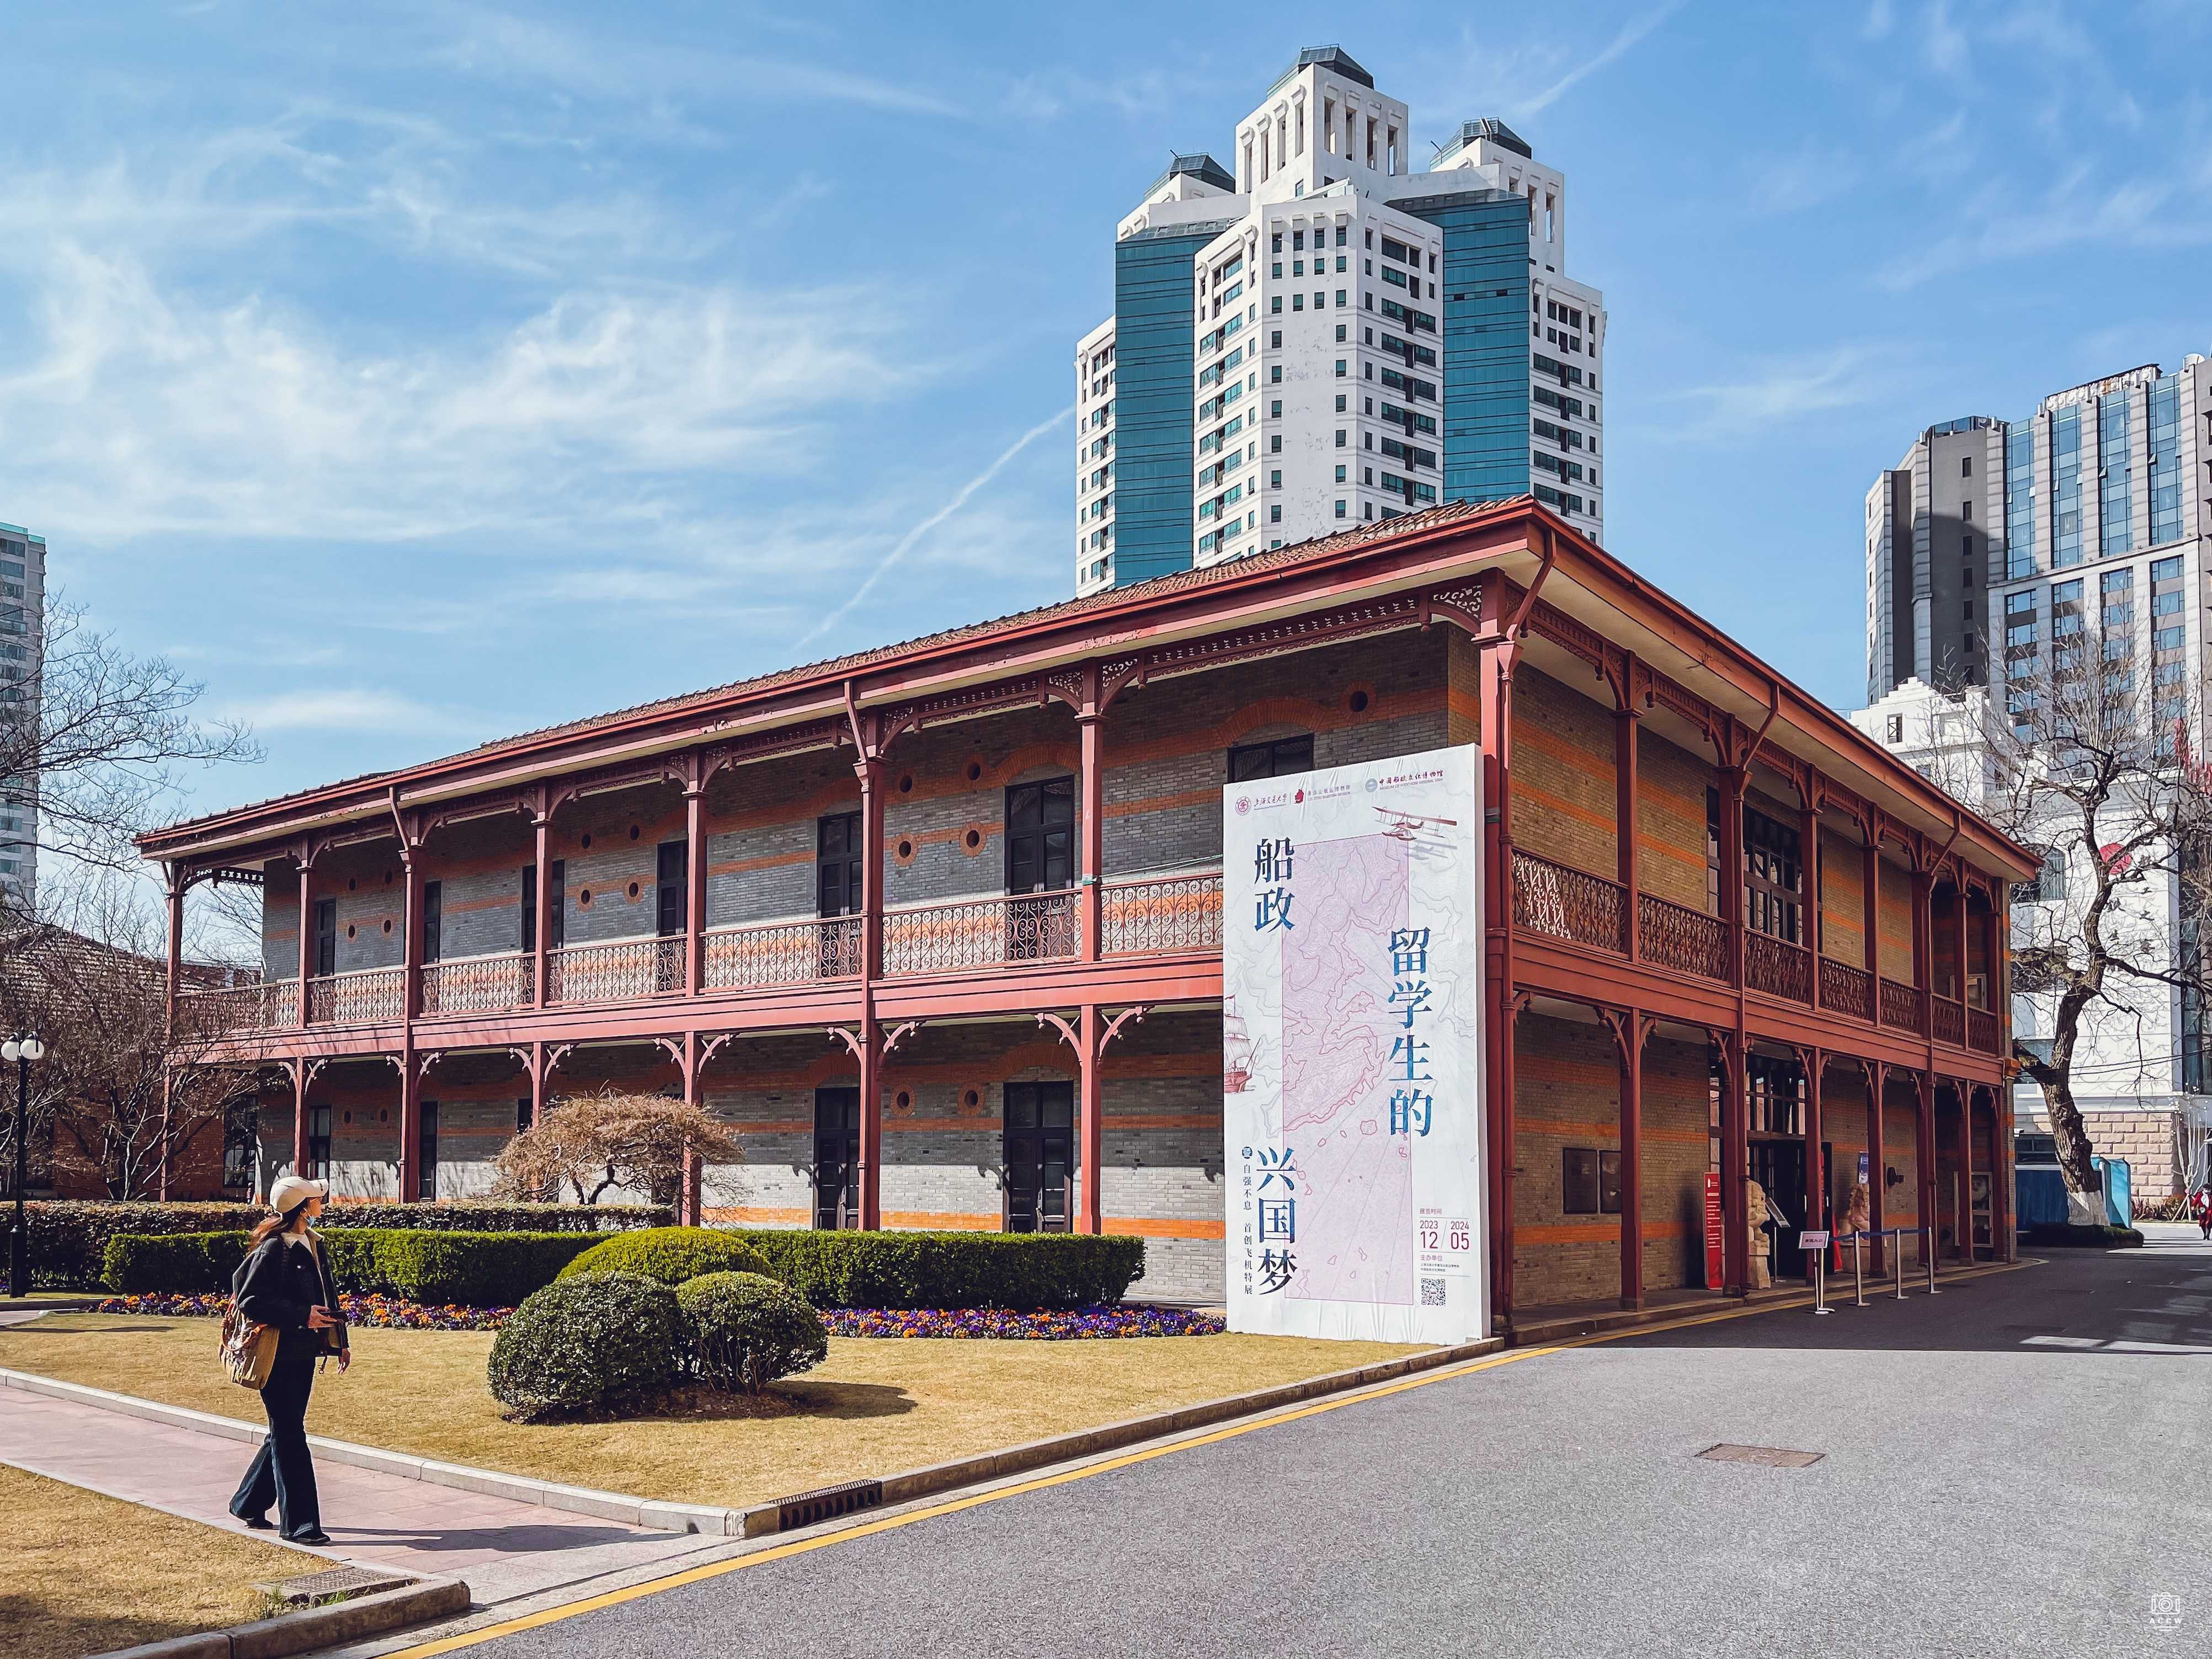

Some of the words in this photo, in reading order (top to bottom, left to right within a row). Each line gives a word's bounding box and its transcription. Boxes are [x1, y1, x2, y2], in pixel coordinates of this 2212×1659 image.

[1254, 792, 1288, 807] 上海交通大学
[1254, 837, 1296, 933] 船政
[1387, 926, 1433, 1137] 留学生的
[1243, 1164, 1252, 1210] 自强不息
[1256, 1146, 1298, 1295] 兴国梦
[1420, 1220, 1438, 1229] 2023
[1451, 1220, 1469, 1230] 2024
[1420, 1231, 1438, 1249] 12
[1451, 1232, 1469, 1250] 05
[1244, 1223, 1252, 1295] 首创飞机特展
